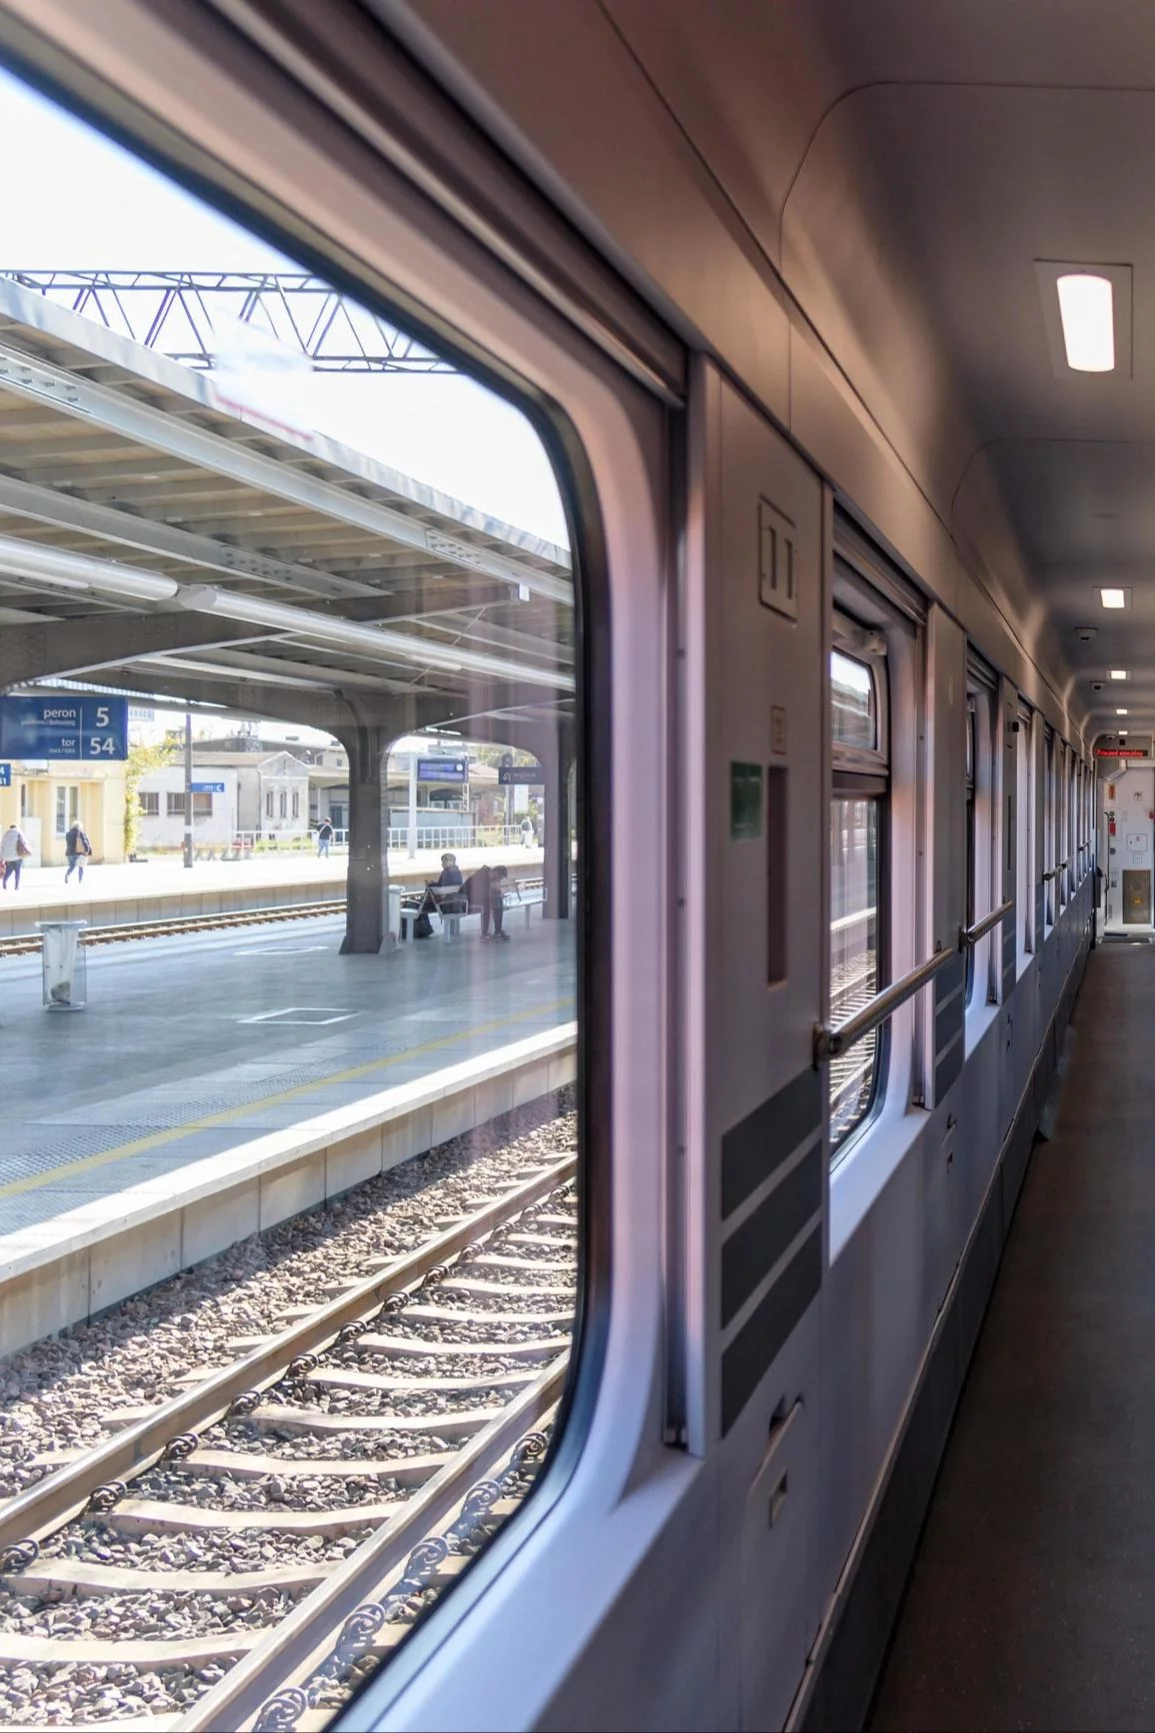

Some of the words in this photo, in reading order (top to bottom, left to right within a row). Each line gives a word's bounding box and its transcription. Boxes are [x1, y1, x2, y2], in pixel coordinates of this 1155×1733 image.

[43, 709, 77, 720] peron
[95, 706, 110, 728] 5
[61, 737, 76, 747] tor
[89, 737, 116, 755] 54
